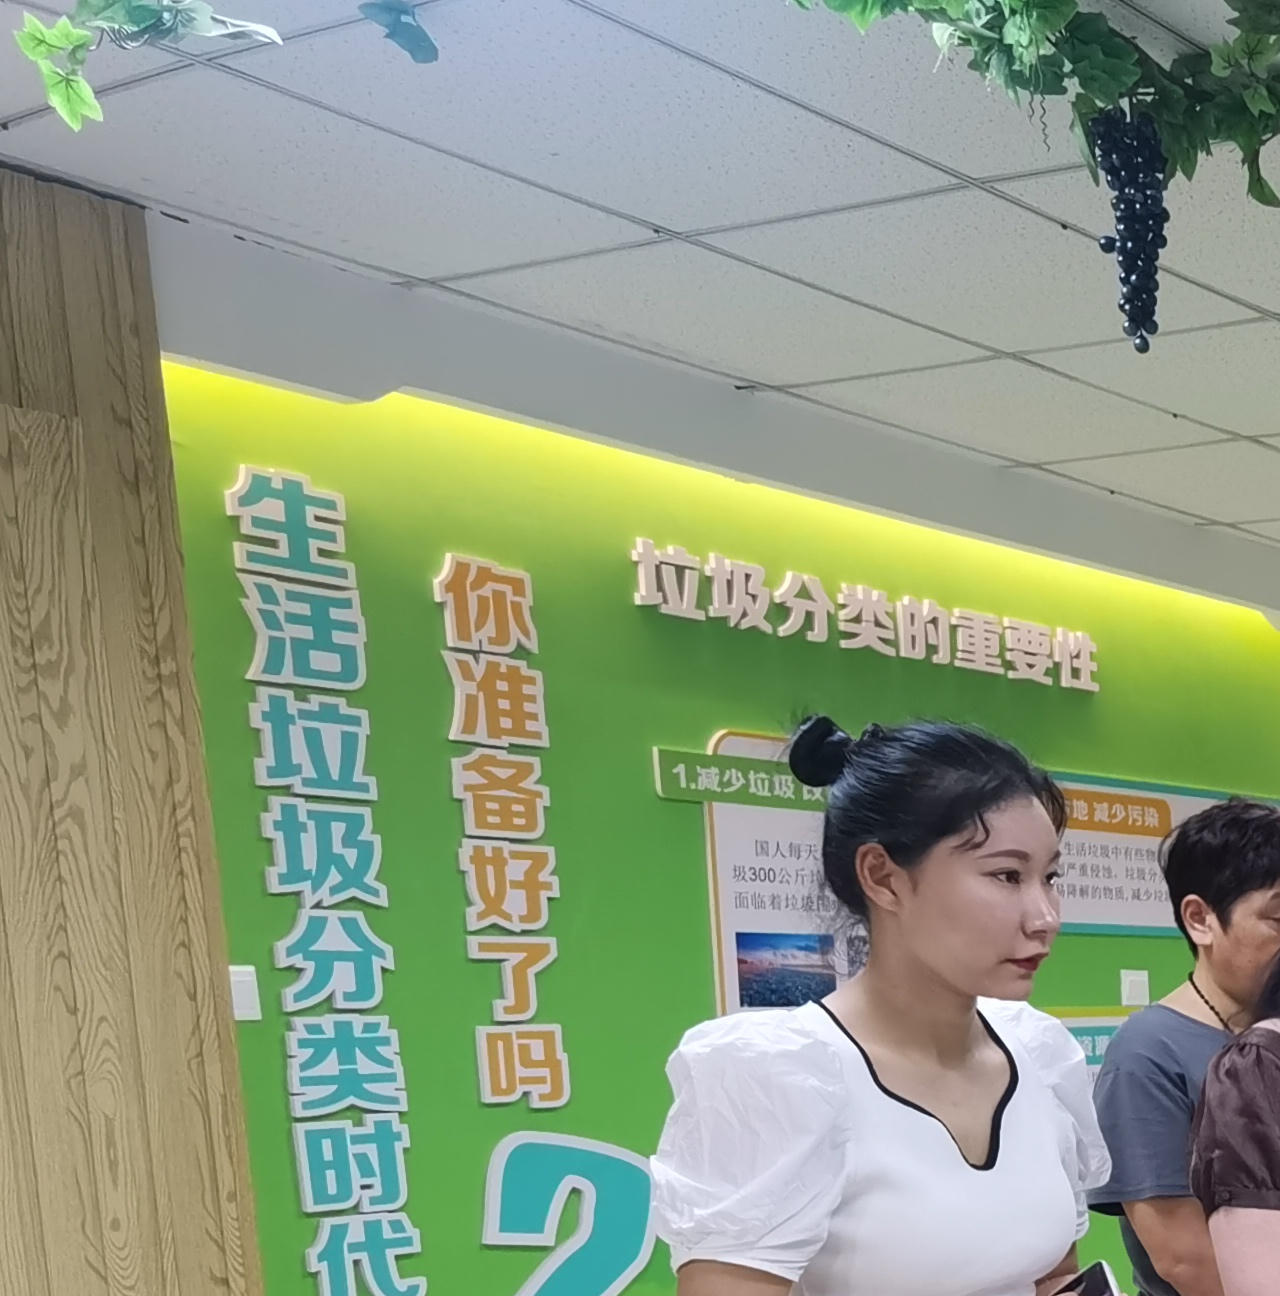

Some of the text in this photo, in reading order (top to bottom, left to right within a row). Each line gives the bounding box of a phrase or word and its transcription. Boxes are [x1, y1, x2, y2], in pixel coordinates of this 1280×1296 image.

[632, 537, 1100, 692] 垃圾分类的重要性
[672, 764, 796, 799] 1.减少垃圾
[1093, 802, 1160, 828] 减少污染
[434, 552, 571, 1108] 你准备好了吗
